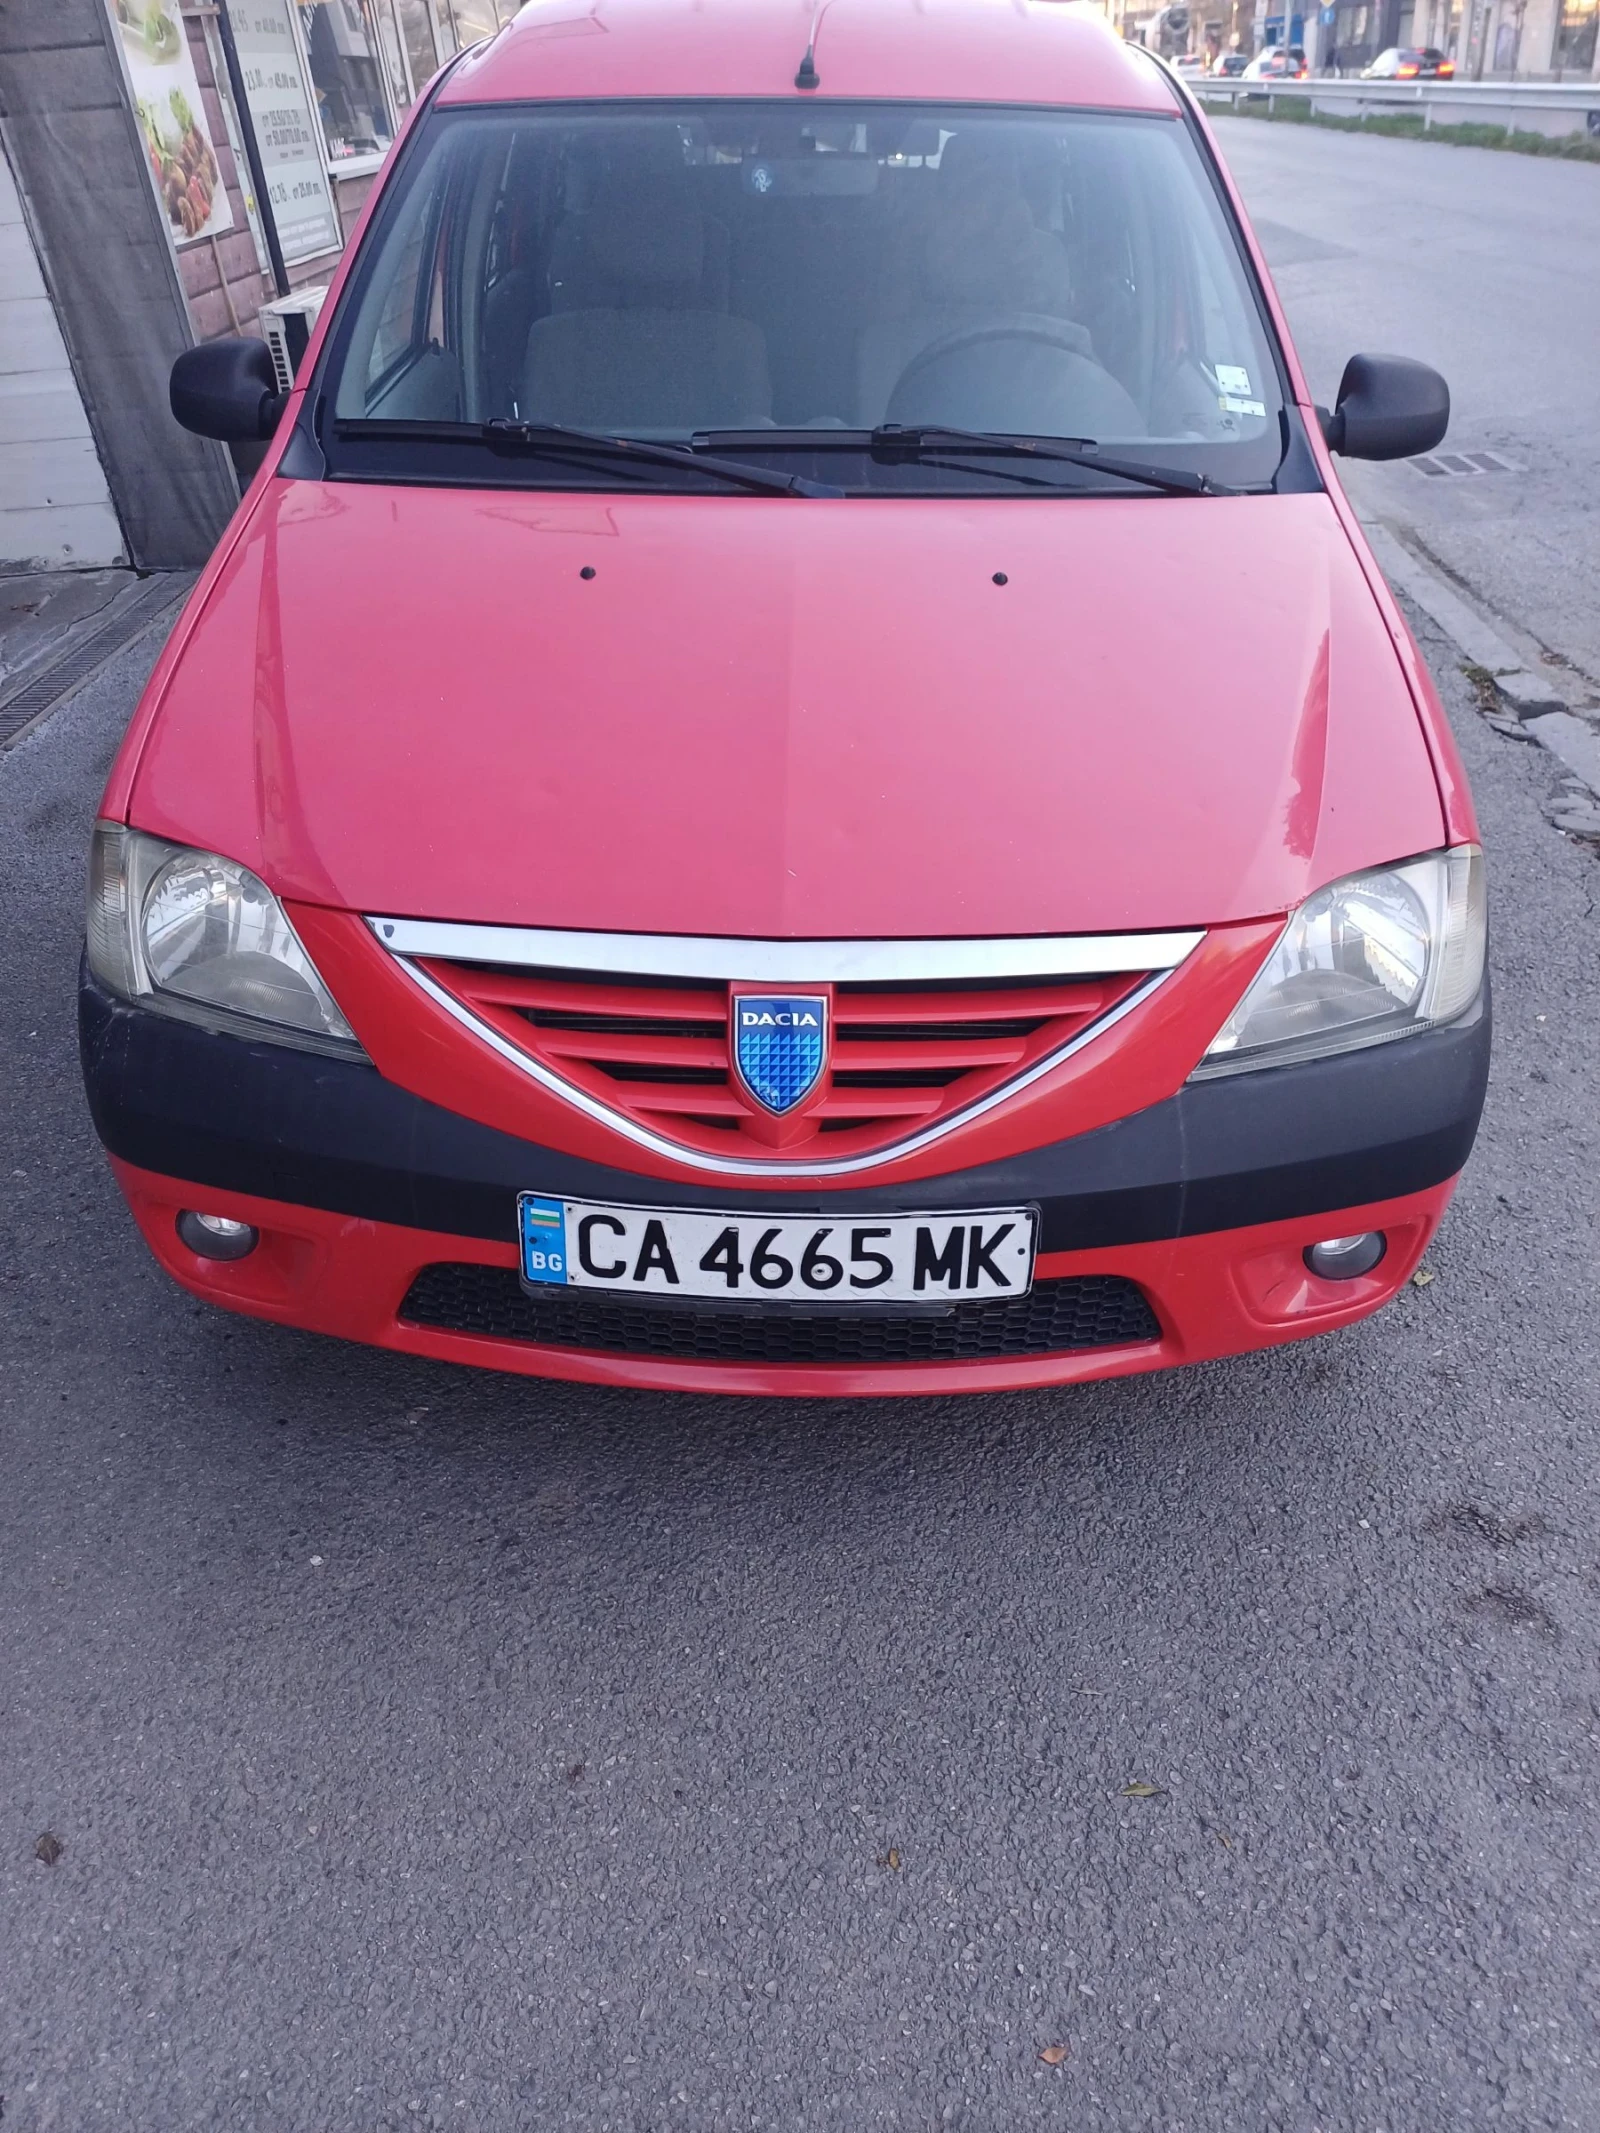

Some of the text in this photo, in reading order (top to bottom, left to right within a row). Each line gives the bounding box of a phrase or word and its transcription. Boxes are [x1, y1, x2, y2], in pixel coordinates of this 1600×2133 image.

[741, 1011, 819, 1028] DACIA
[531, 1249, 563, 1272] BG
[577, 1213, 1016, 1291] CA 4665 MK
